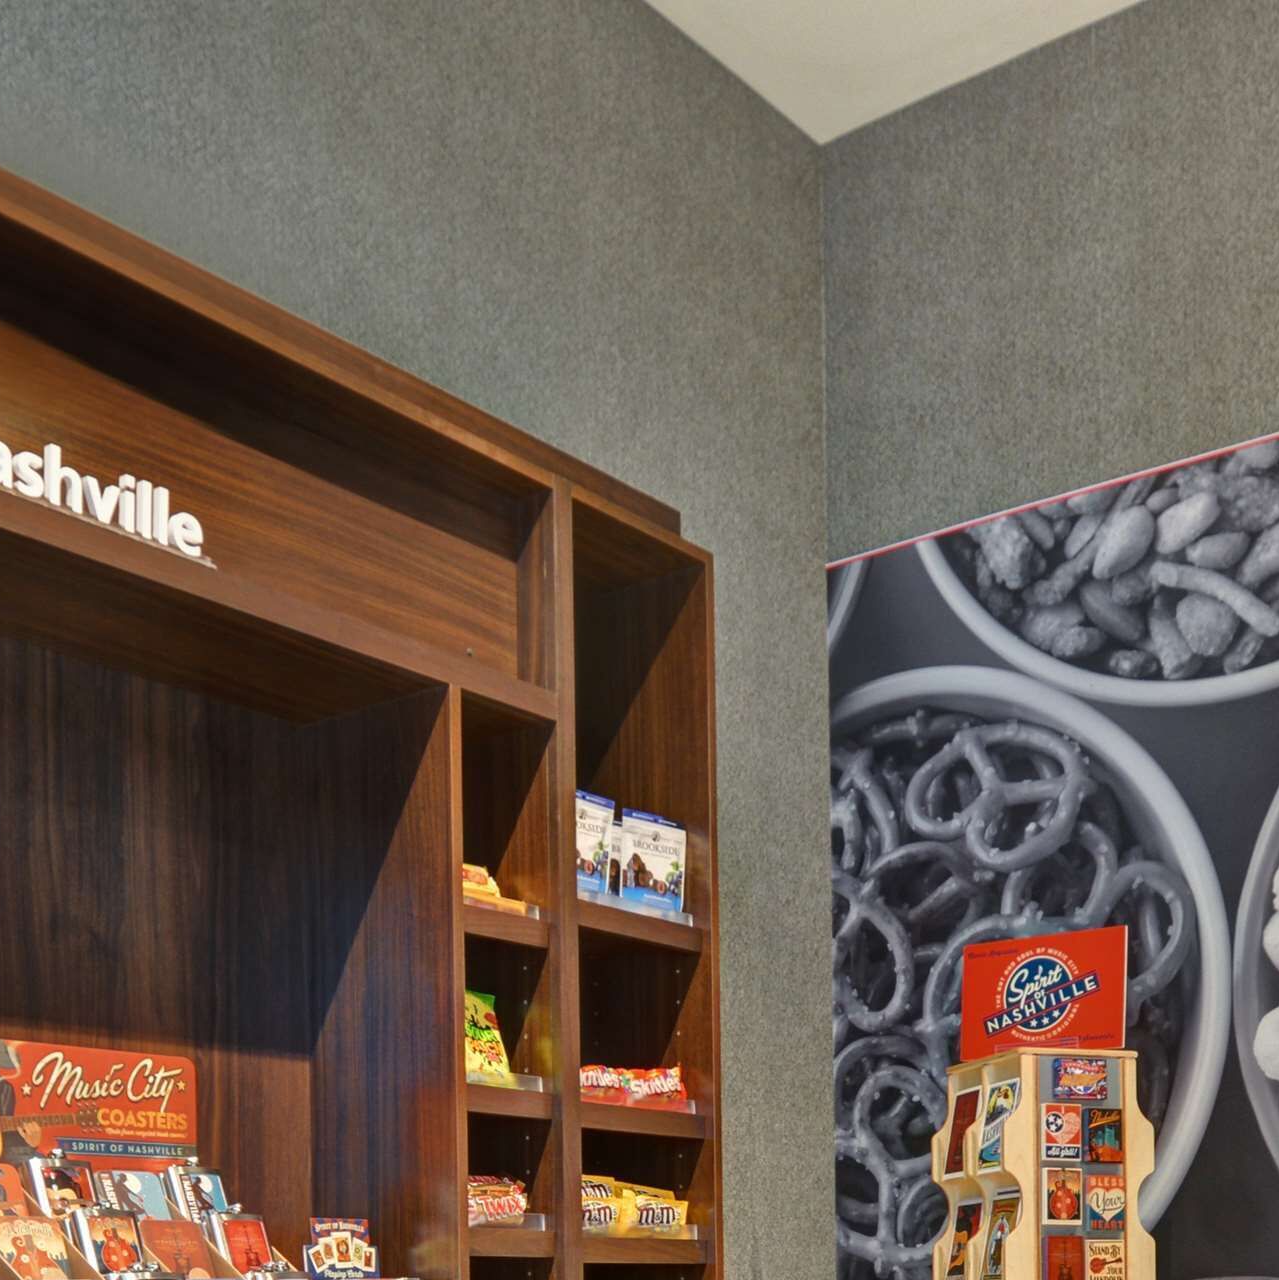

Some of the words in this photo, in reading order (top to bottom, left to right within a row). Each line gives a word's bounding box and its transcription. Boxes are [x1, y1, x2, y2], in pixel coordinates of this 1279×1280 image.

[1008, 964, 1063, 1010] Spirit
[1034, 989, 1046, 999] OF
[986, 976, 1097, 1032] NASHVILLE
[32, 1051, 124, 1109] Music
[127, 1058, 183, 1112] City
[630, 1073, 683, 1096] Skittles
[97, 1108, 187, 1130] COASTERS
[71, 1142, 106, 1152] SPIRIT
[110, 1143, 124, 1152] OF
[128, 1145, 183, 1156] NASHVILLE
[481, 1197, 526, 1218] TWIX
[1089, 1191, 1125, 1208] Your
[1092, 1221, 1124, 1230] HEART
[1089, 1245, 1110, 1257] STAND
